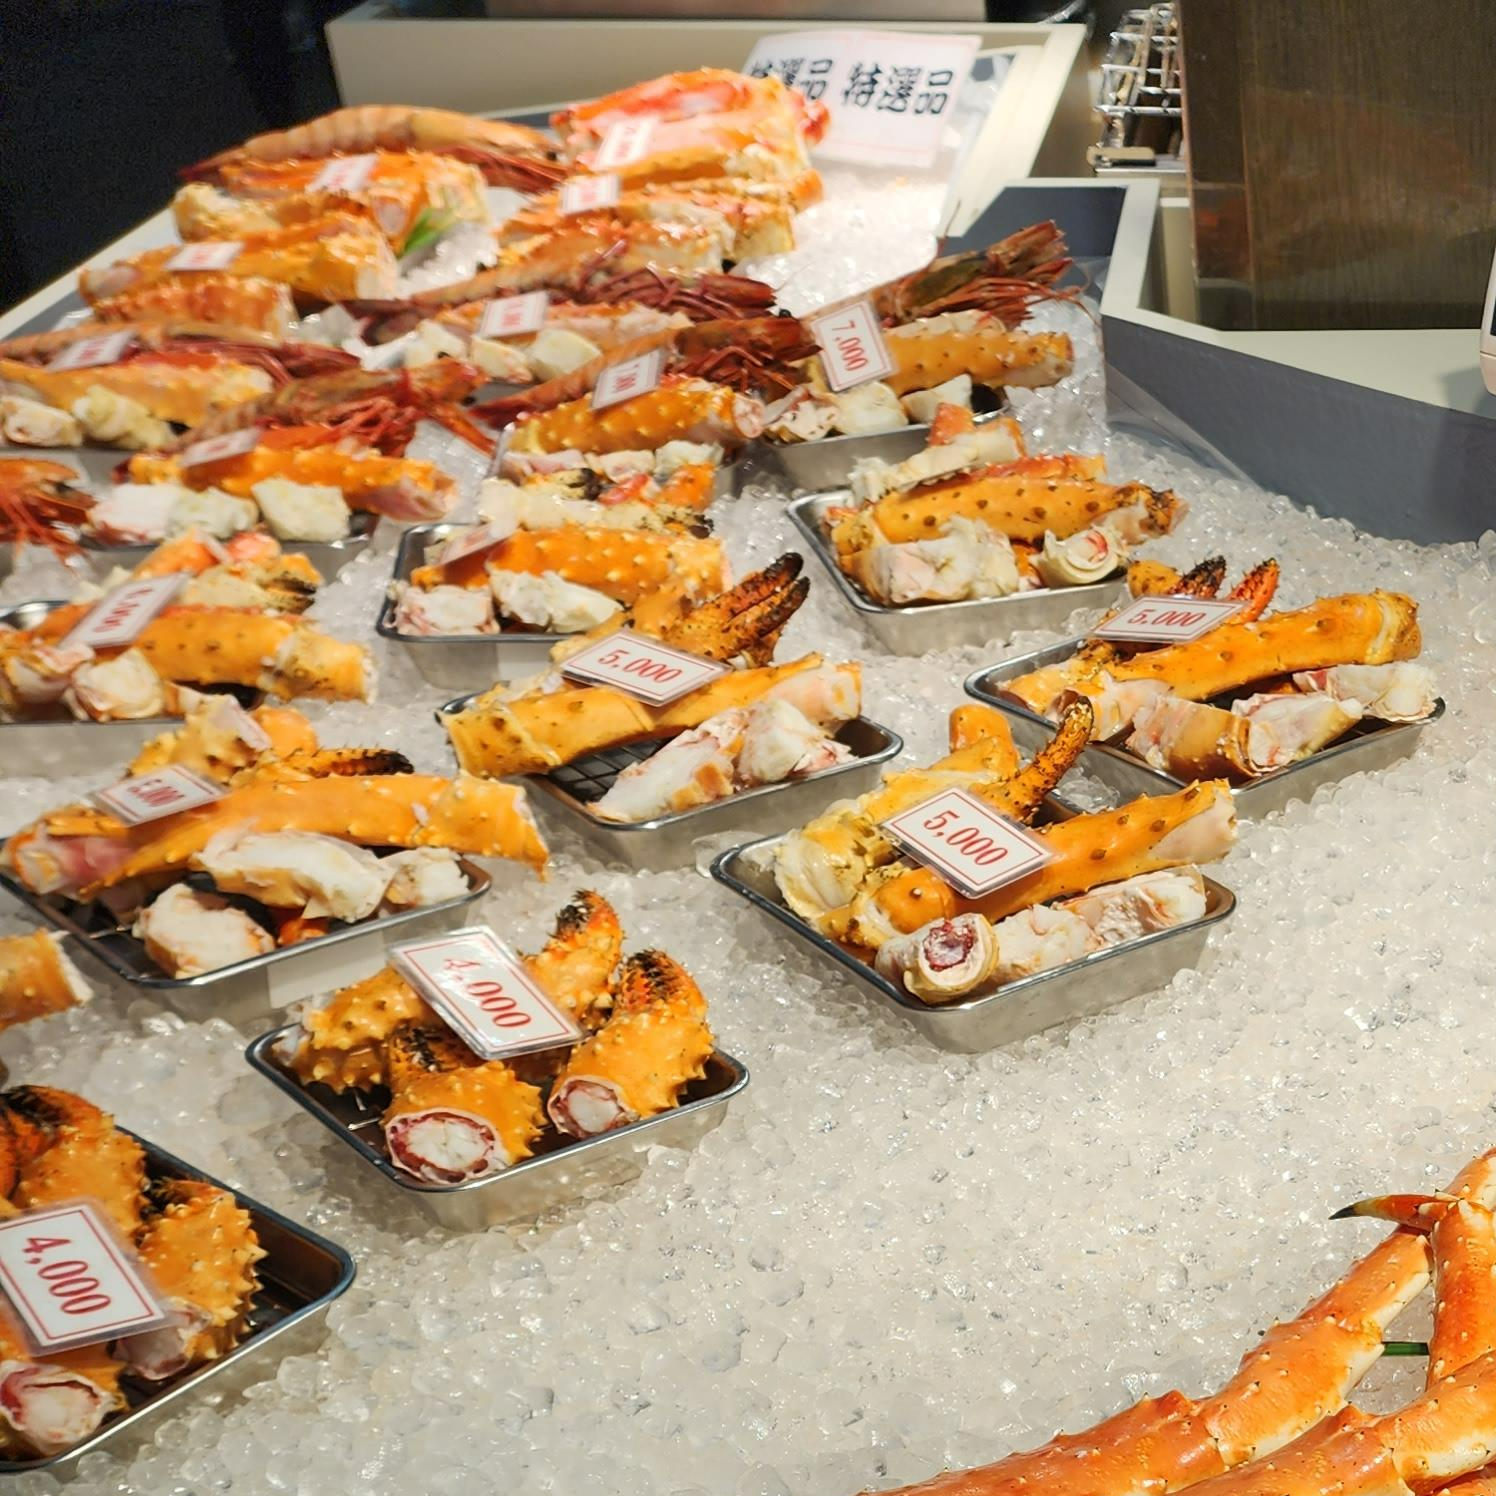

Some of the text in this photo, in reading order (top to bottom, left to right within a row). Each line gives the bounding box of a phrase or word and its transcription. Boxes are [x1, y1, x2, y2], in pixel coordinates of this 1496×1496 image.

[842, 61, 953, 115] 特選品
[923, 810, 1009, 866] 5,000
[443, 958, 532, 1028] 4,000
[22, 1237, 112, 1315] 4,000
